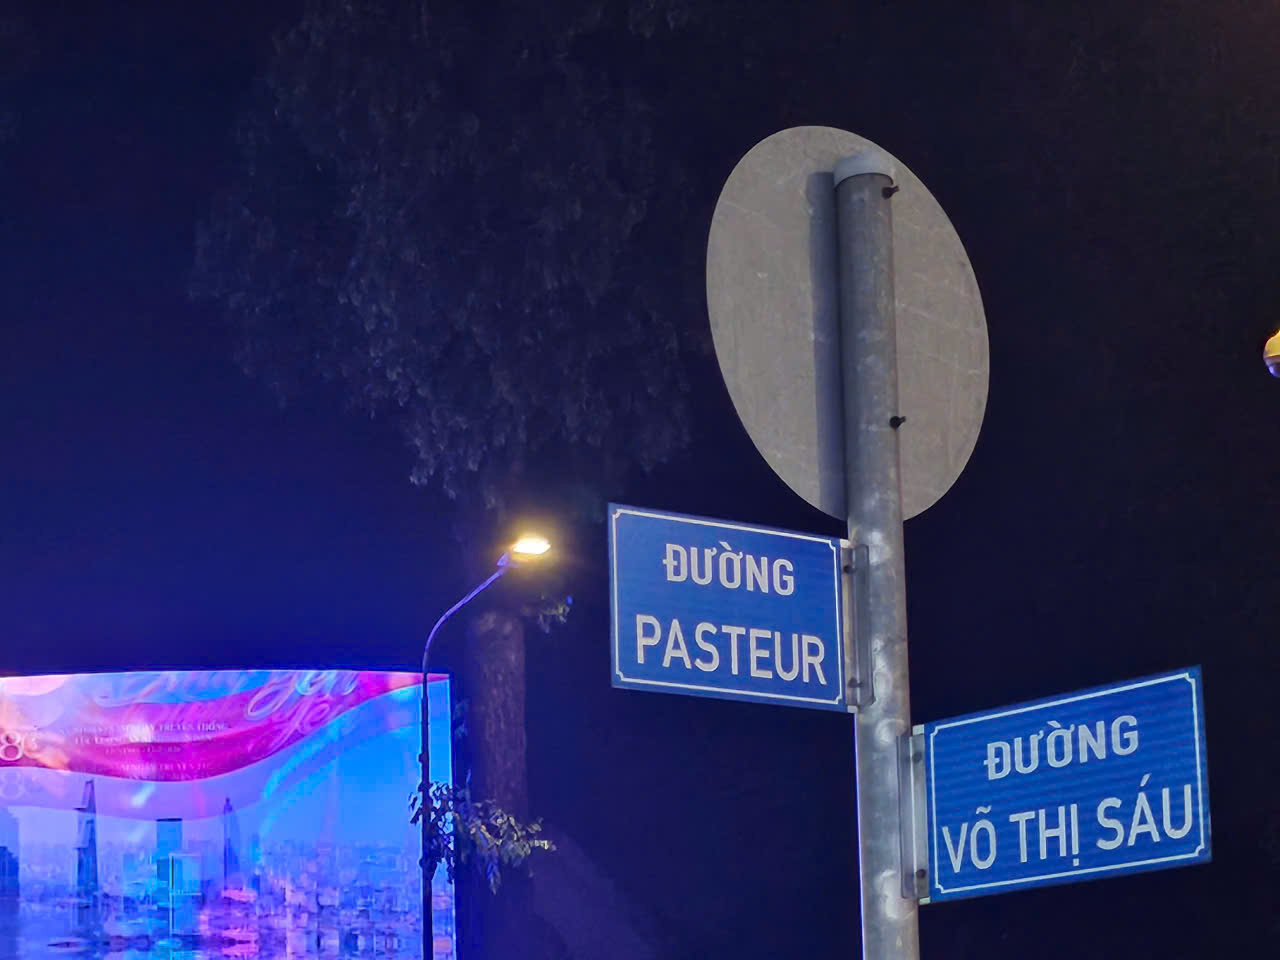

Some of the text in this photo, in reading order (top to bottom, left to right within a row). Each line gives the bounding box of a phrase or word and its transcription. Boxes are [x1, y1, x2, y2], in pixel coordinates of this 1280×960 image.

[663, 541, 795, 596] ĐƯỜNG
[635, 614, 827, 686] PASTEUR
[983, 715, 1140, 780] ĐƯỜNG
[942, 775, 1193, 873] VÕ THỊ SÁU
